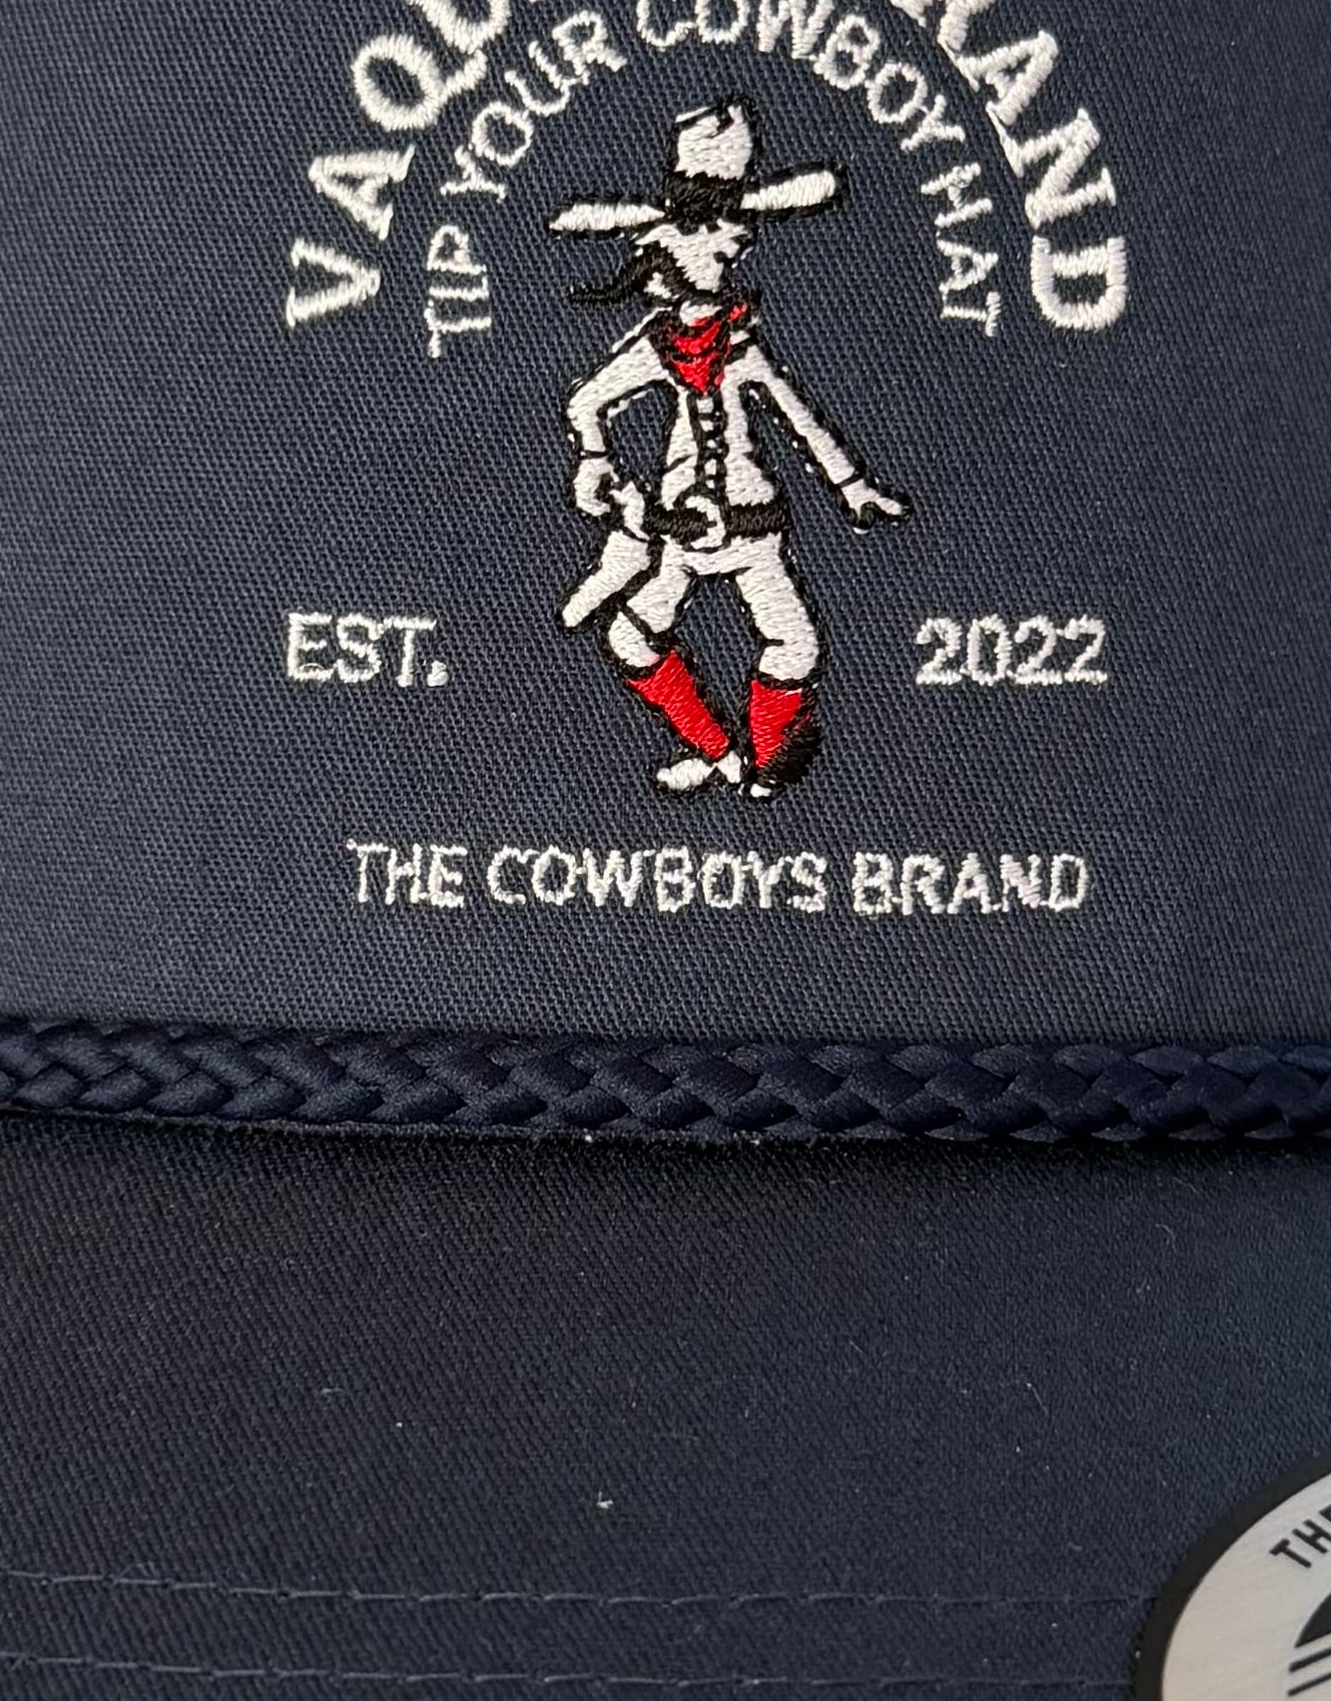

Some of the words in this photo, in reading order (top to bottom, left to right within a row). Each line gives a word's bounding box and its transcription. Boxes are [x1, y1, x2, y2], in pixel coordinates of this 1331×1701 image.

[440, 9, 628, 203] YOUR
[424, 224, 493, 359] TIP
[920, 162, 1007, 337] HAT
[286, 611, 448, 687] EST.
[914, 614, 1108, 687] 2022
[346, 838, 468, 909] THE
[487, 844, 828, 915] COWBOYS
[851, 851, 1089, 916] BRAND
